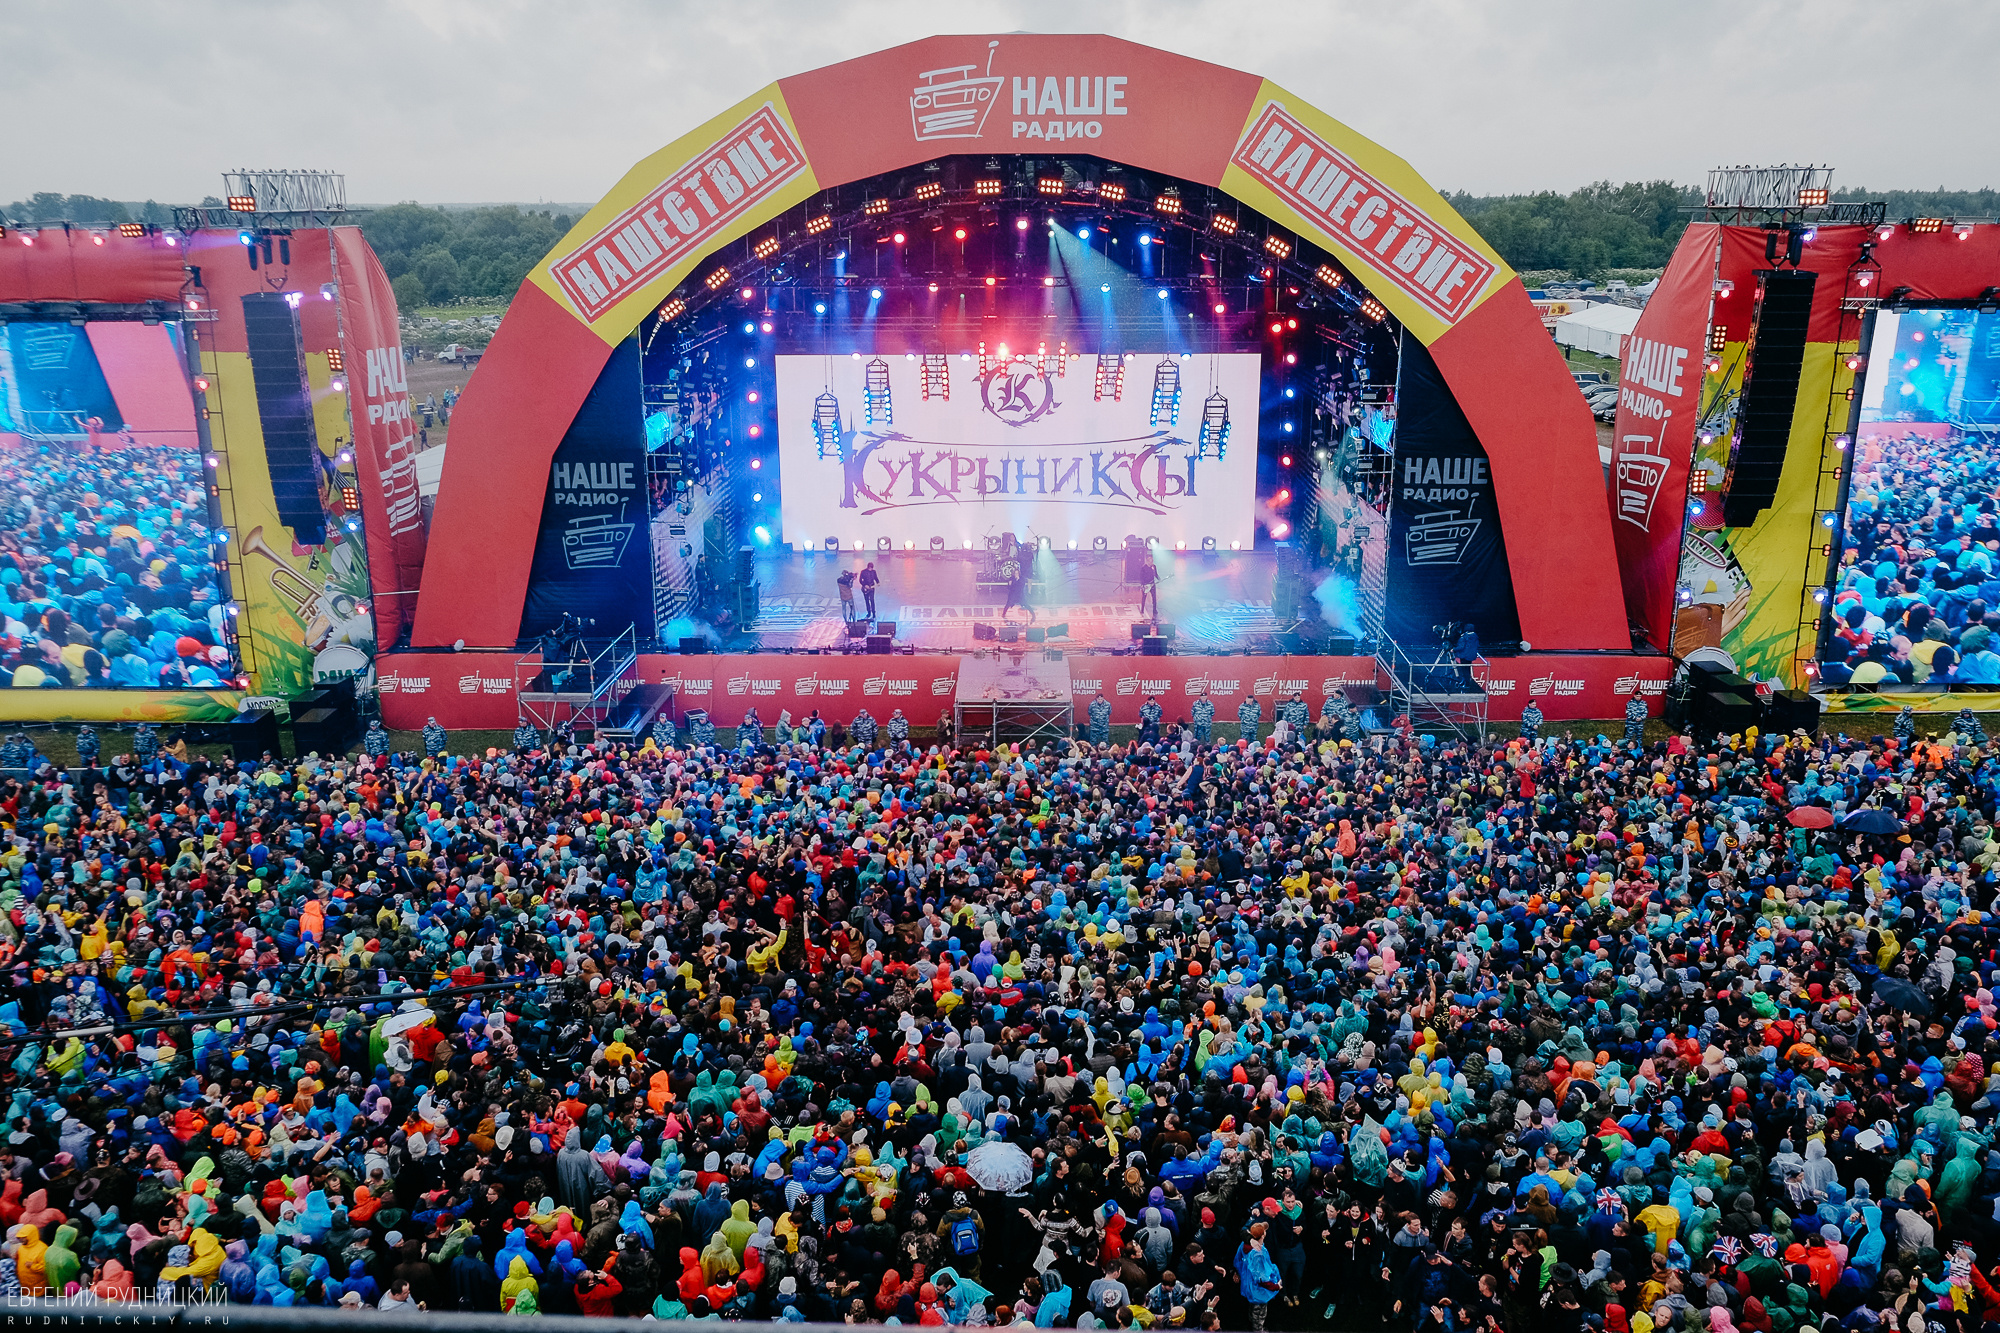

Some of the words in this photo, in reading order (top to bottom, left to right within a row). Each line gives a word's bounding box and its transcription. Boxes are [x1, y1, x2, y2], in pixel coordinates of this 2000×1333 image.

[1013, 76, 1128, 115] НАШЕ
[1013, 121, 1102, 141] РАДИО
[568, 125, 787, 306] НАШЕСТВИЕ
[1250, 121, 1476, 305] НАШЕСТВИЕ
[1625, 335, 1688, 397] НАШЕ
[1621, 387, 1664, 420] РАДИО
[553, 462, 636, 489] НАШЕ
[839, 430, 1198, 511] КУКРЫНИКСЫ
[1404, 457, 1489, 485] НАШЕ
[554, 493, 619, 507] РАДИО
[1403, 488, 1469, 502] РАДИО
[401, 677, 431, 688] НАШЕ
[483, 678, 512, 689] НАШЕ
[684, 679, 713, 690] НАШЕ
[752, 679, 781, 690] НАШЕ
[820, 679, 849, 690] НАШЕ
[888, 679, 918, 690] НАШЕ
[1072, 679, 1103, 690] НАШЕ
[1141, 679, 1171, 690] НАШЕ
[1210, 679, 1240, 690] НАШЕ
[1279, 679, 1309, 690] НАШЕ
[1555, 679, 1585, 690] НАШЕ
[1640, 679, 1669, 690] НАШЕ
